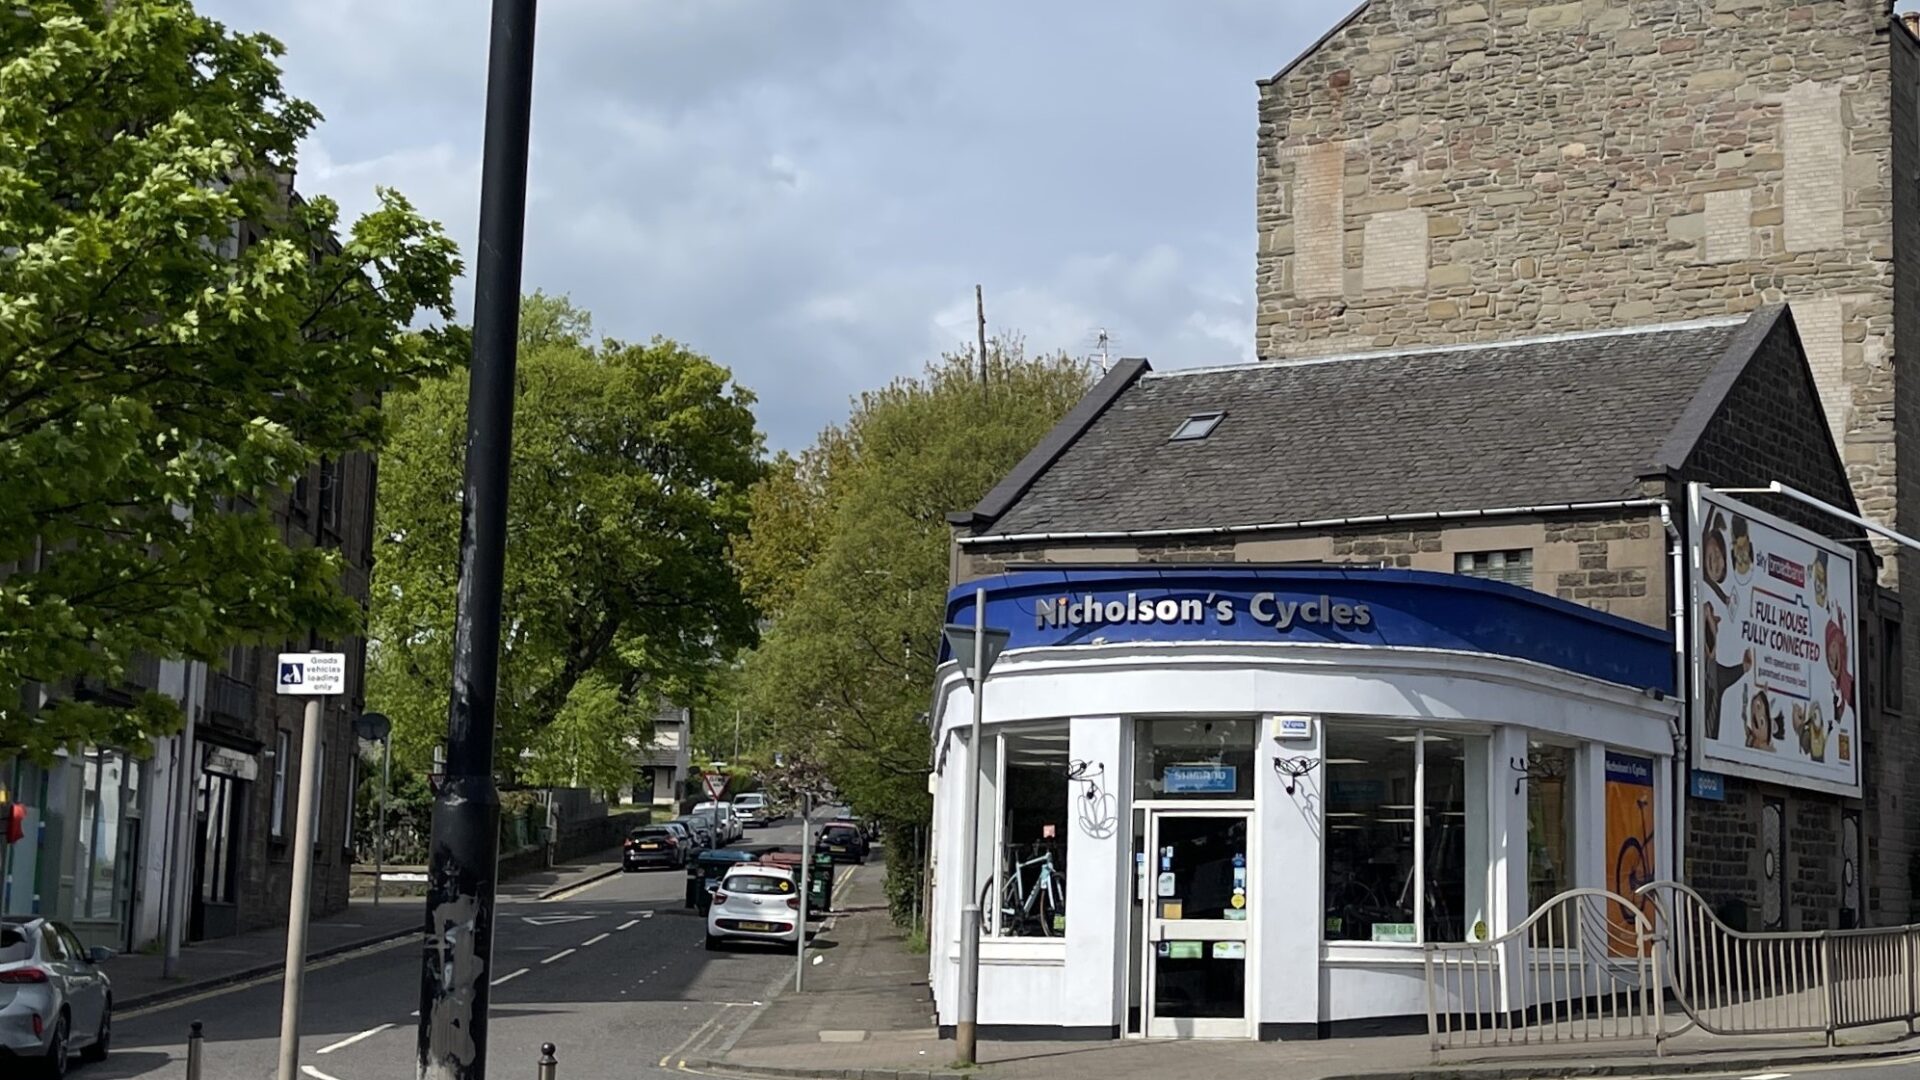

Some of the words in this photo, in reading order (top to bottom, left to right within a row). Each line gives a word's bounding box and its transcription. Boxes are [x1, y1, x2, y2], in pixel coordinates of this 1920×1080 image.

[1035, 592, 1235, 627] Nicholson's
[1250, 592, 1372, 629] Cycles
[1755, 600, 1777, 626] FULL
[1779, 609, 1808, 636] HOUSE
[1741, 620, 1768, 647] FULLY
[1770, 630, 1821, 662] CONNECTED
[310, 656, 338, 664] Goods
[306, 665, 341, 673] vehicles
[307, 674, 339, 682] loading
[313, 683, 332, 691] only
